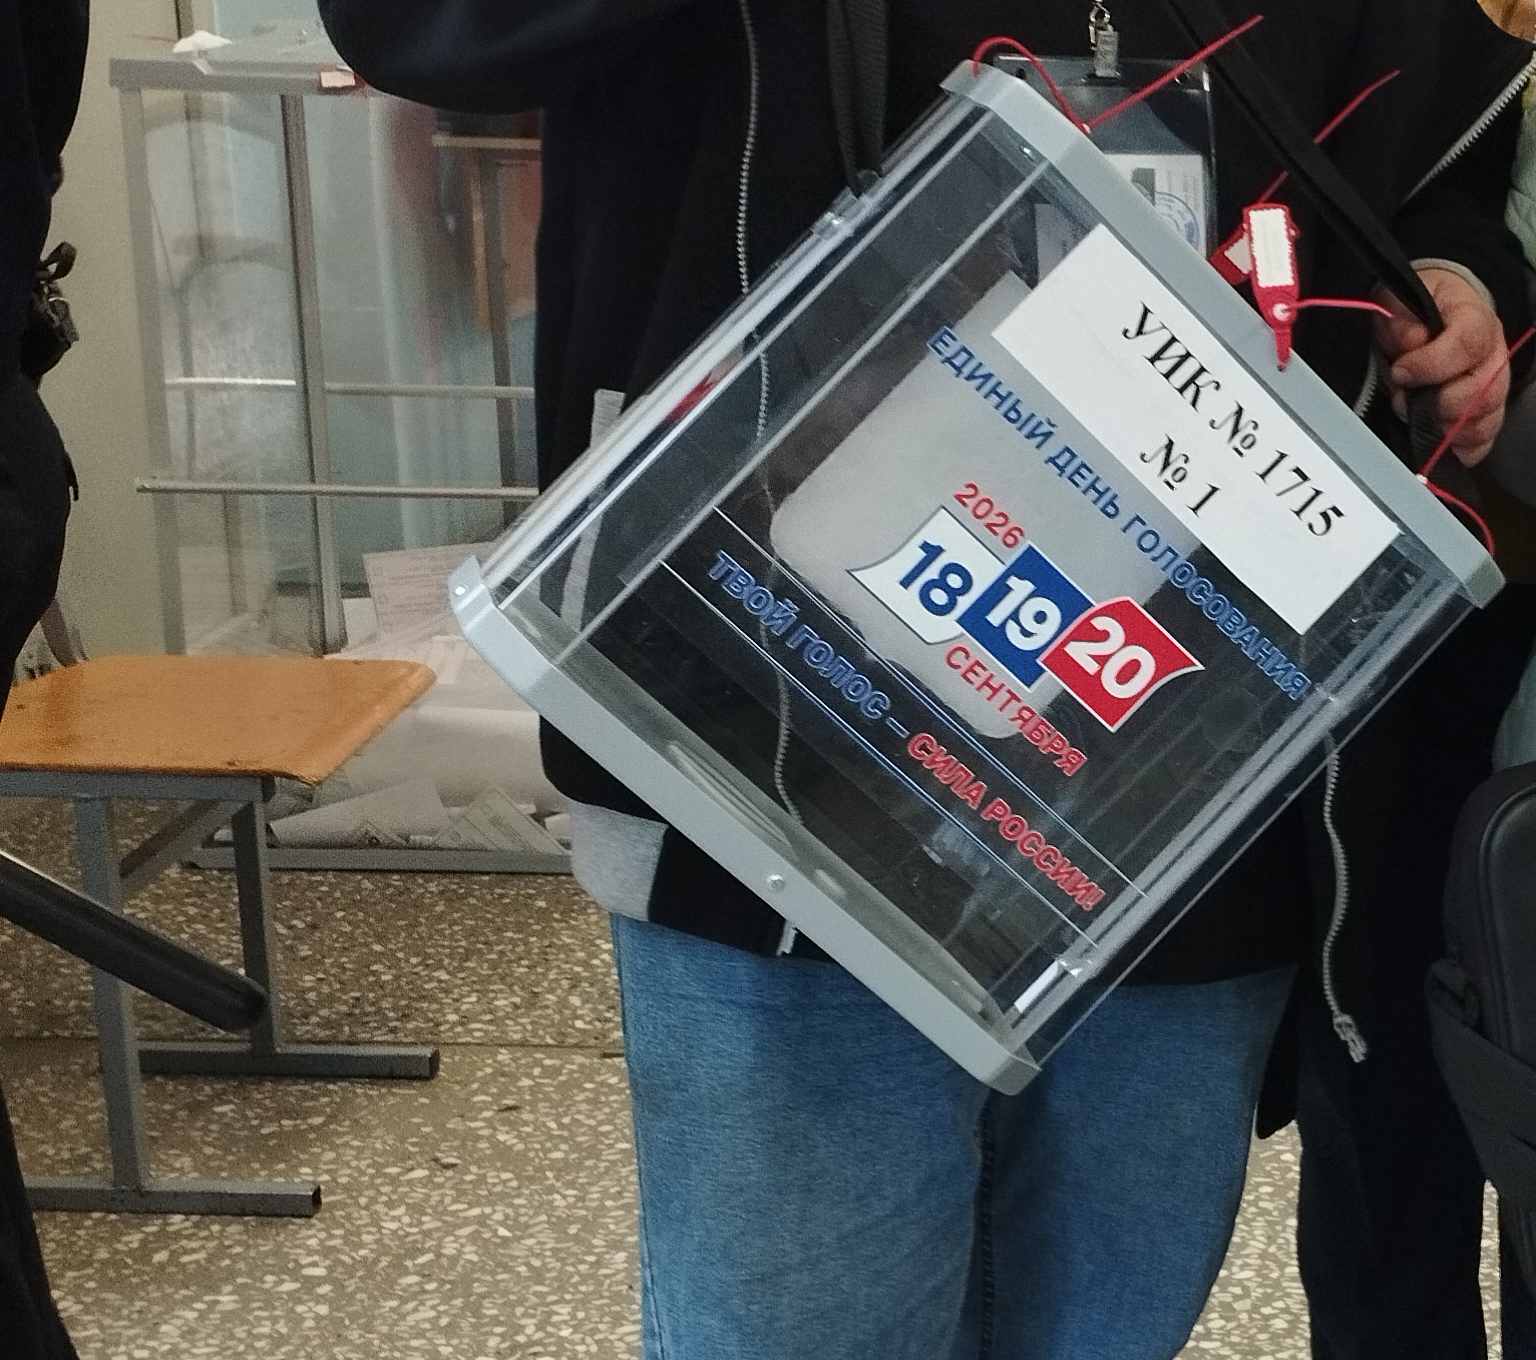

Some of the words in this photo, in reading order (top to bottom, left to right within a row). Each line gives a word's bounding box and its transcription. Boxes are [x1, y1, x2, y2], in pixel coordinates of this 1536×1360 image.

[1122, 301, 1221, 412] УИК
[1209, 400, 1259, 458] №
[1255, 449, 1345, 536] 1715
[1140, 433, 1190, 491] №
[1187, 483, 1222, 519] 1
[926, 325, 1058, 450] ЕДИНЫЙ
[1044, 445, 1120, 520] ДЕНЬ
[1121, 513, 1312, 701] ГОЛОСОВАНИЯ
[953, 481, 1025, 549] 2026
[899, 540, 973, 616] 18
[986, 575, 1062, 651] 19
[1064, 616, 1156, 699] 20
[708, 549, 800, 636] ТВОЙ
[785, 624, 891, 719] ГОЛОС
[907, 732, 988, 810] СИЛА
[980, 797, 1105, 911] РОССИИ!
[945, 644, 1088, 776] СЕНТЯБРЯ
